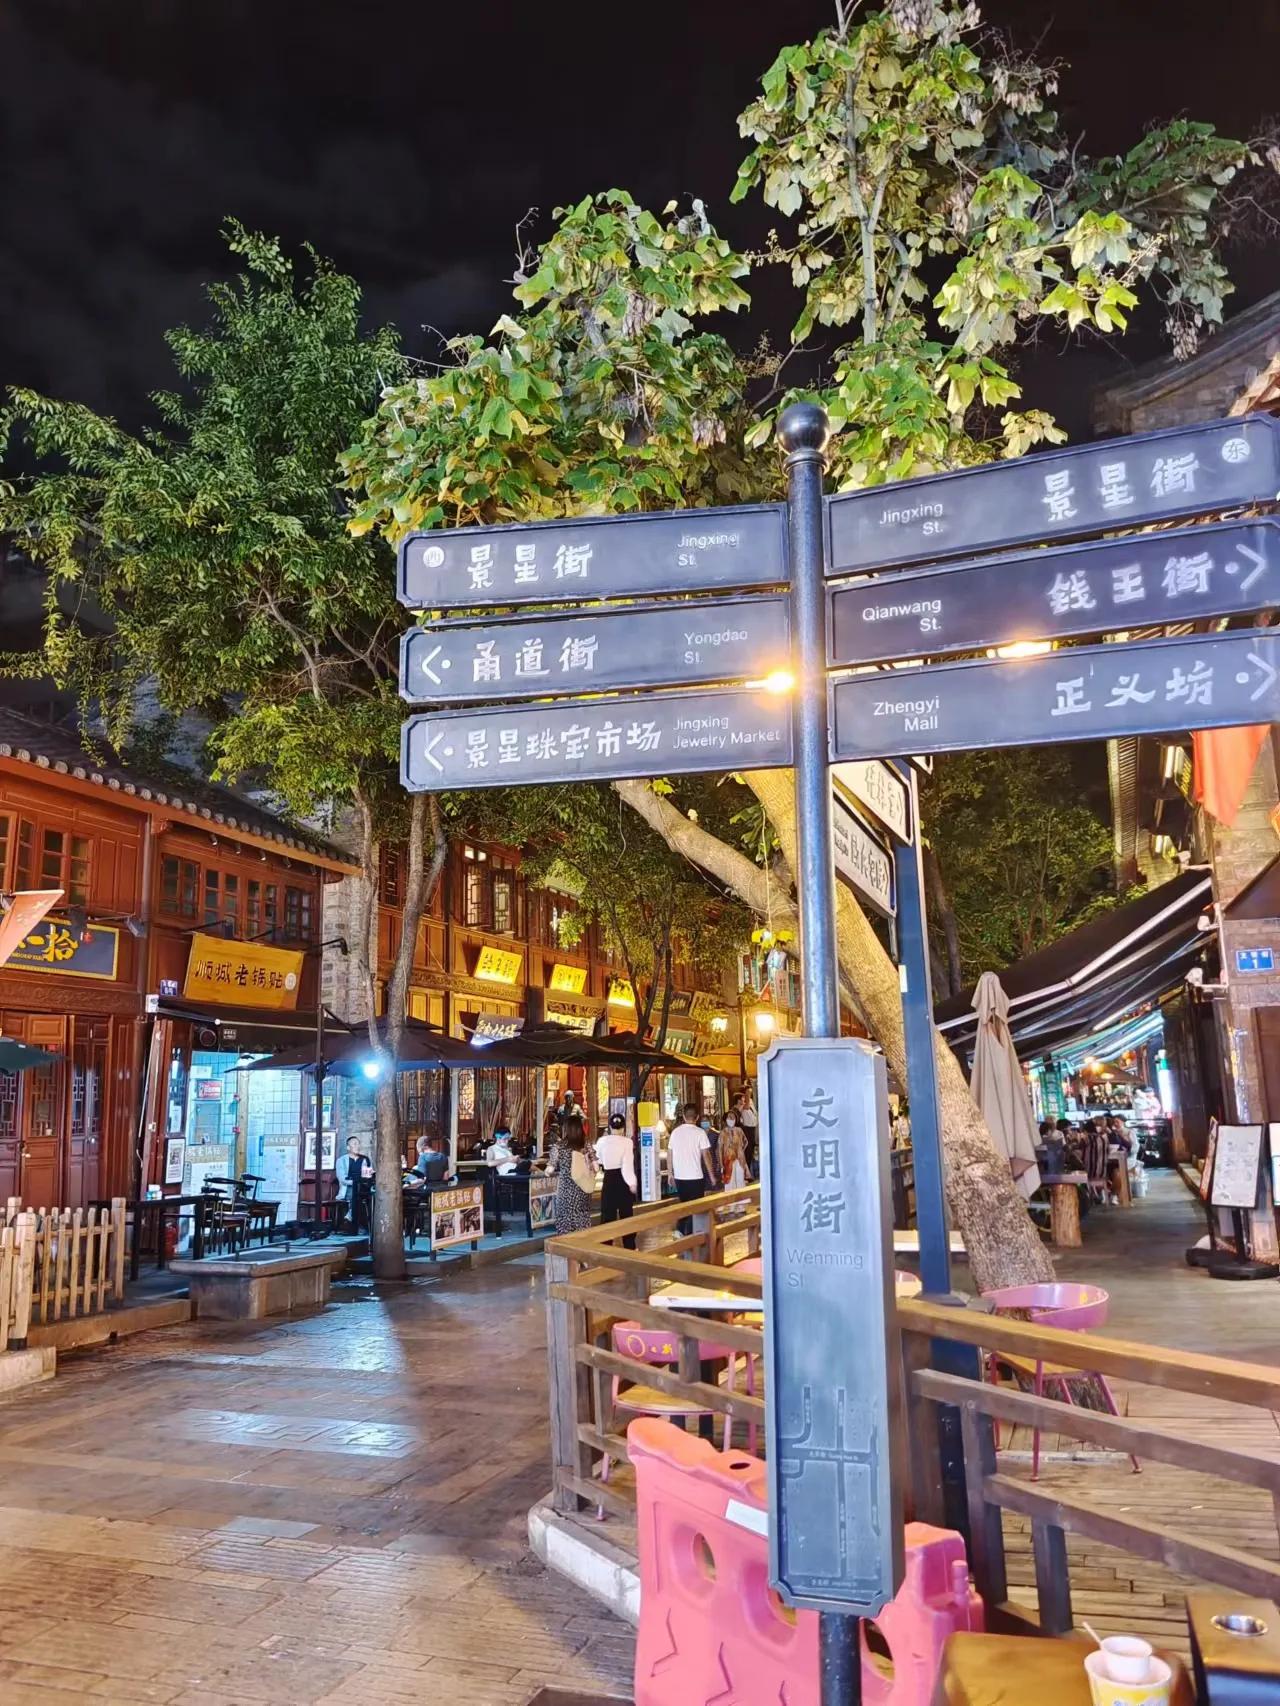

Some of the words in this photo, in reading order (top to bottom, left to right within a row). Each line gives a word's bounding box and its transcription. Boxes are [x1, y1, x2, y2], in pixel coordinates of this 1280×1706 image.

[1225, 440, 1248, 461] 东
[1041, 452, 1200, 522] 景星街
[879, 502, 943, 525] Jingxing
[922, 520, 943, 536] St.
[677, 532, 740, 549] Jingxing
[467, 543, 594, 590] 景星街
[1047, 552, 1214, 615] 钱王街
[861, 599, 942, 621] Qianwang
[919, 616, 942, 632] St.
[684, 628, 748, 647] Yongdao
[473, 635, 599, 682] 甬道街
[1050, 660, 1213, 716] 正义坊
[873, 695, 940, 718] Zhengyi
[673, 714, 729, 731] Jingxing
[904, 715, 939, 732] Mall
[465, 720, 662, 769] 景星珠宝市场
[673, 733, 727, 750] Jewelry
[731, 728, 781, 745] Market
[194, 959, 283, 989] 顺城老锅贴
[800, 1087, 846, 1234] 文明街
[786, 1247, 864, 1270] Wenming
